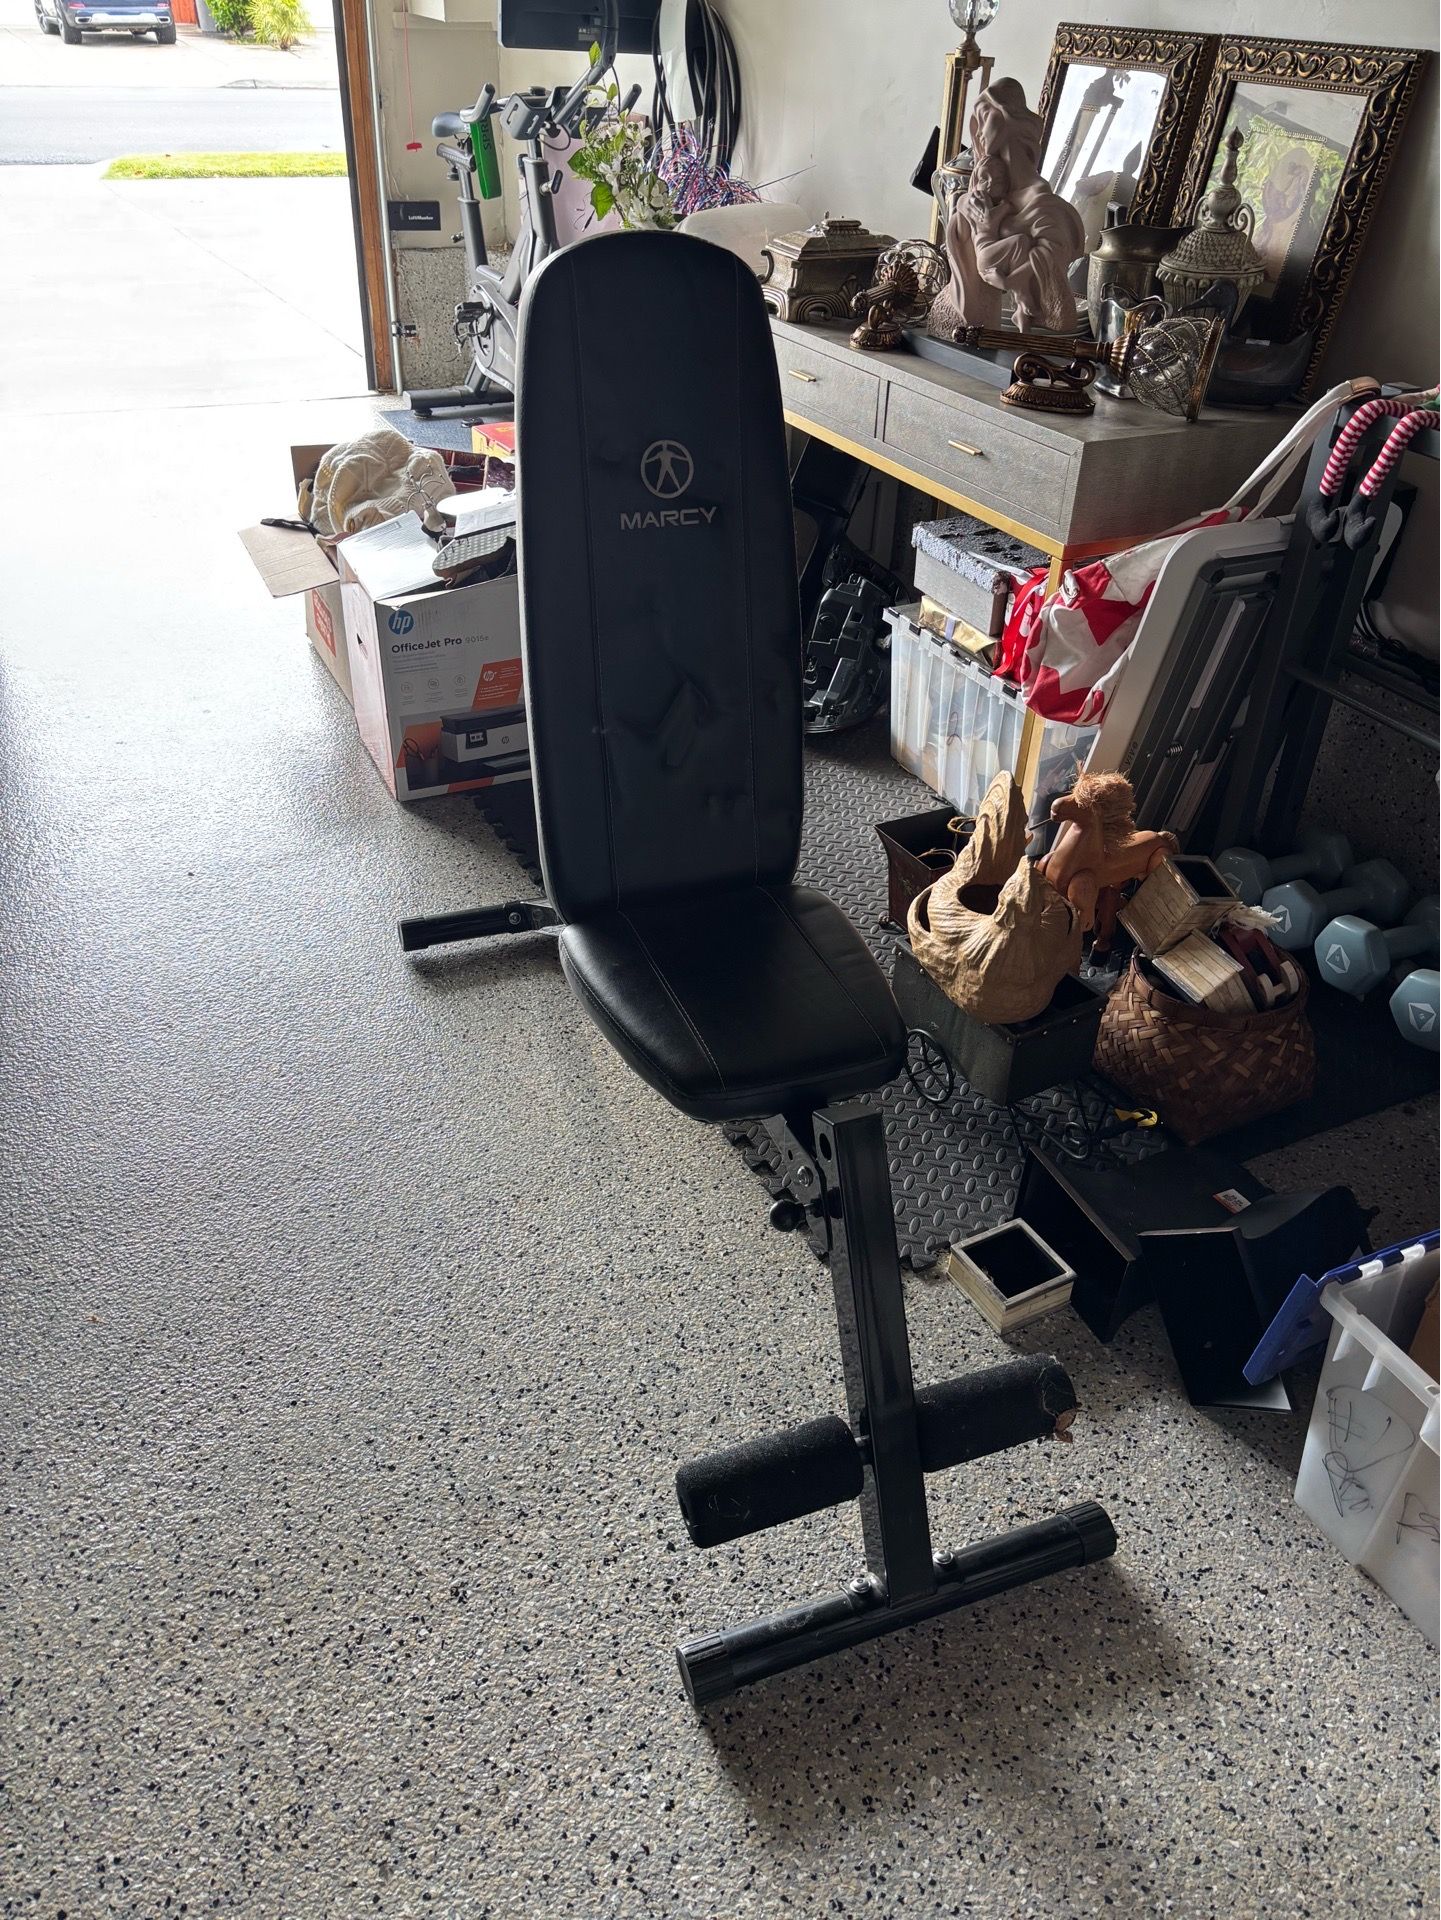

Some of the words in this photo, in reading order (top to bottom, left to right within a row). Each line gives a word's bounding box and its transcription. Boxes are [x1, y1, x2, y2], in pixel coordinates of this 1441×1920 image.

[620, 506, 717, 531] MARCY
[390, 609, 413, 636] hp
[391, 639, 441, 653] OfficeJet
[444, 637, 463, 646] Pro
